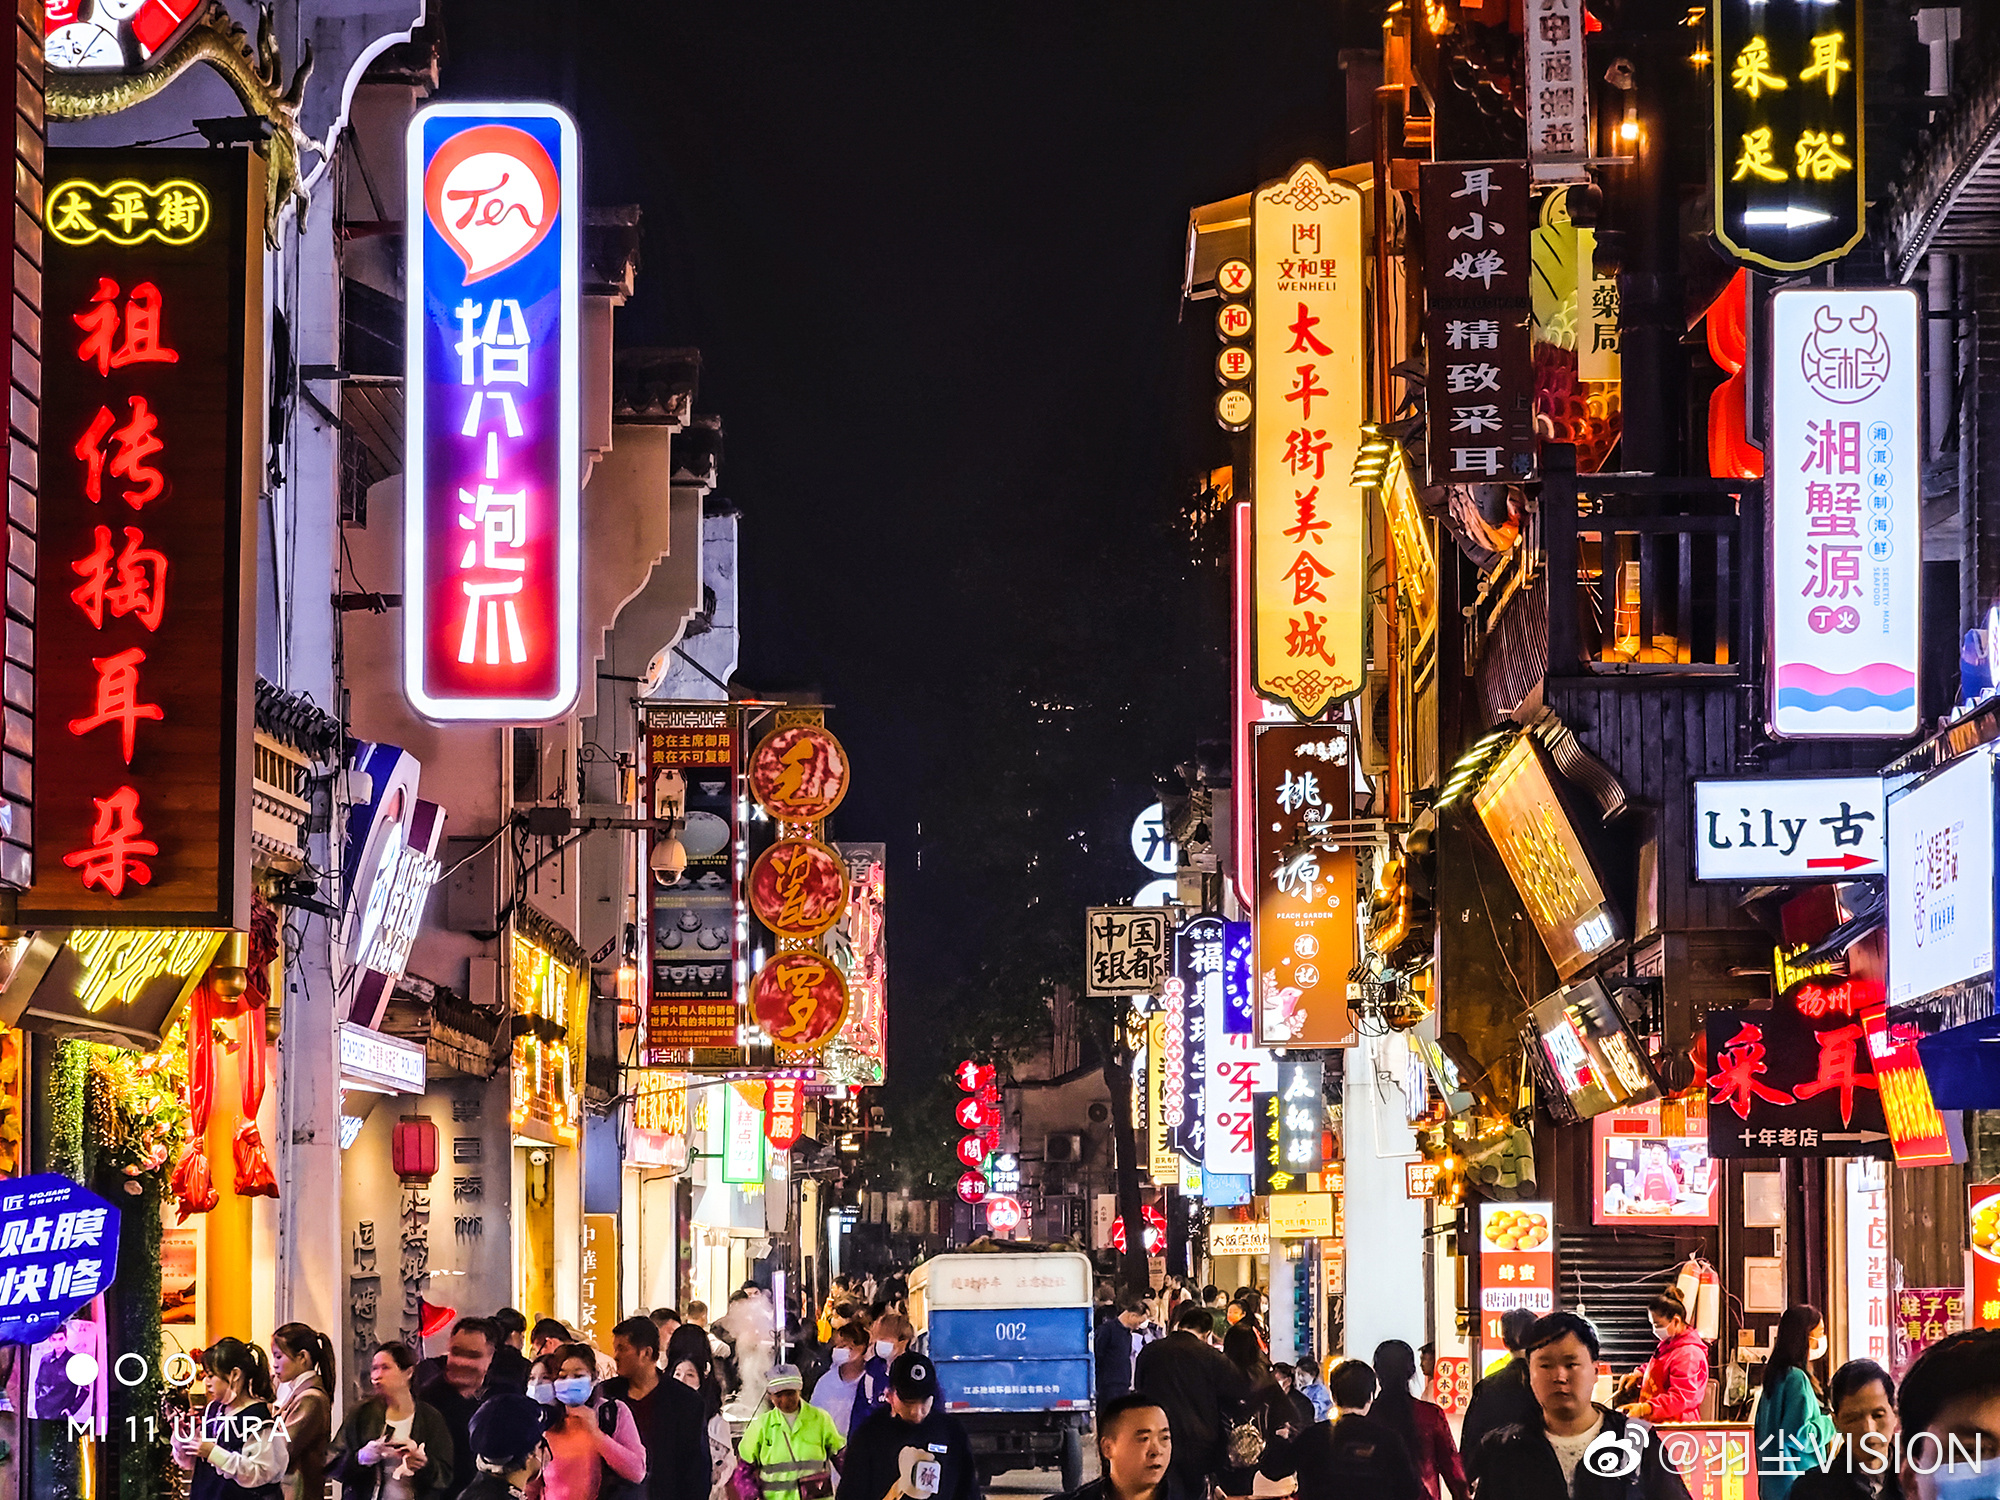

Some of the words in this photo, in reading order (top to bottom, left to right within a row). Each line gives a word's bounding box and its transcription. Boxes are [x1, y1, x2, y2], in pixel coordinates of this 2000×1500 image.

[1731, 33, 1851, 98] 采耳
[1731, 126, 1853, 182] 足浴
[55, 190, 200, 232] 太平街
[446, 172, 539, 229] Ten
[1445, 167, 1508, 290] 耳小婵
[1277, 258, 1338, 280] 文和里
[1277, 282, 1337, 291] WENHELI
[1223, 264, 1248, 375] 文和里
[1445, 319, 1504, 476] 精致采耳
[1280, 302, 1336, 667] 太平街美食城
[1872, 426, 1888, 556] 湘派秘制海鲜
[1800, 418, 1863, 600] 湘蟹源
[63, 277, 180, 898] 祖传掏耳朵
[1873, 566, 1881, 607] SEAFOOD
[652, 734, 731, 748] 珍在主席御用
[652, 750, 731, 764] 贵在不可复制
[1705, 808, 1808, 856] Lily
[1093, 917, 1161, 952] 中国
[1093, 947, 1164, 985] 银都
[1797, 982, 1852, 1016] 扬州
[651, 1017, 736, 1027] 世界人民的共同财富
[1706, 1021, 1879, 1130] 采耳
[1738, 1127, 1819, 1148] 十年老店
[960, 1180, 985, 1194] 茶馆
[0, 1207, 108, 1258] 贴膜
[0, 1258, 103, 1306] 快修
[1498, 1263, 1536, 1281] 蜂蜜
[995, 1322, 1027, 1341] 002
